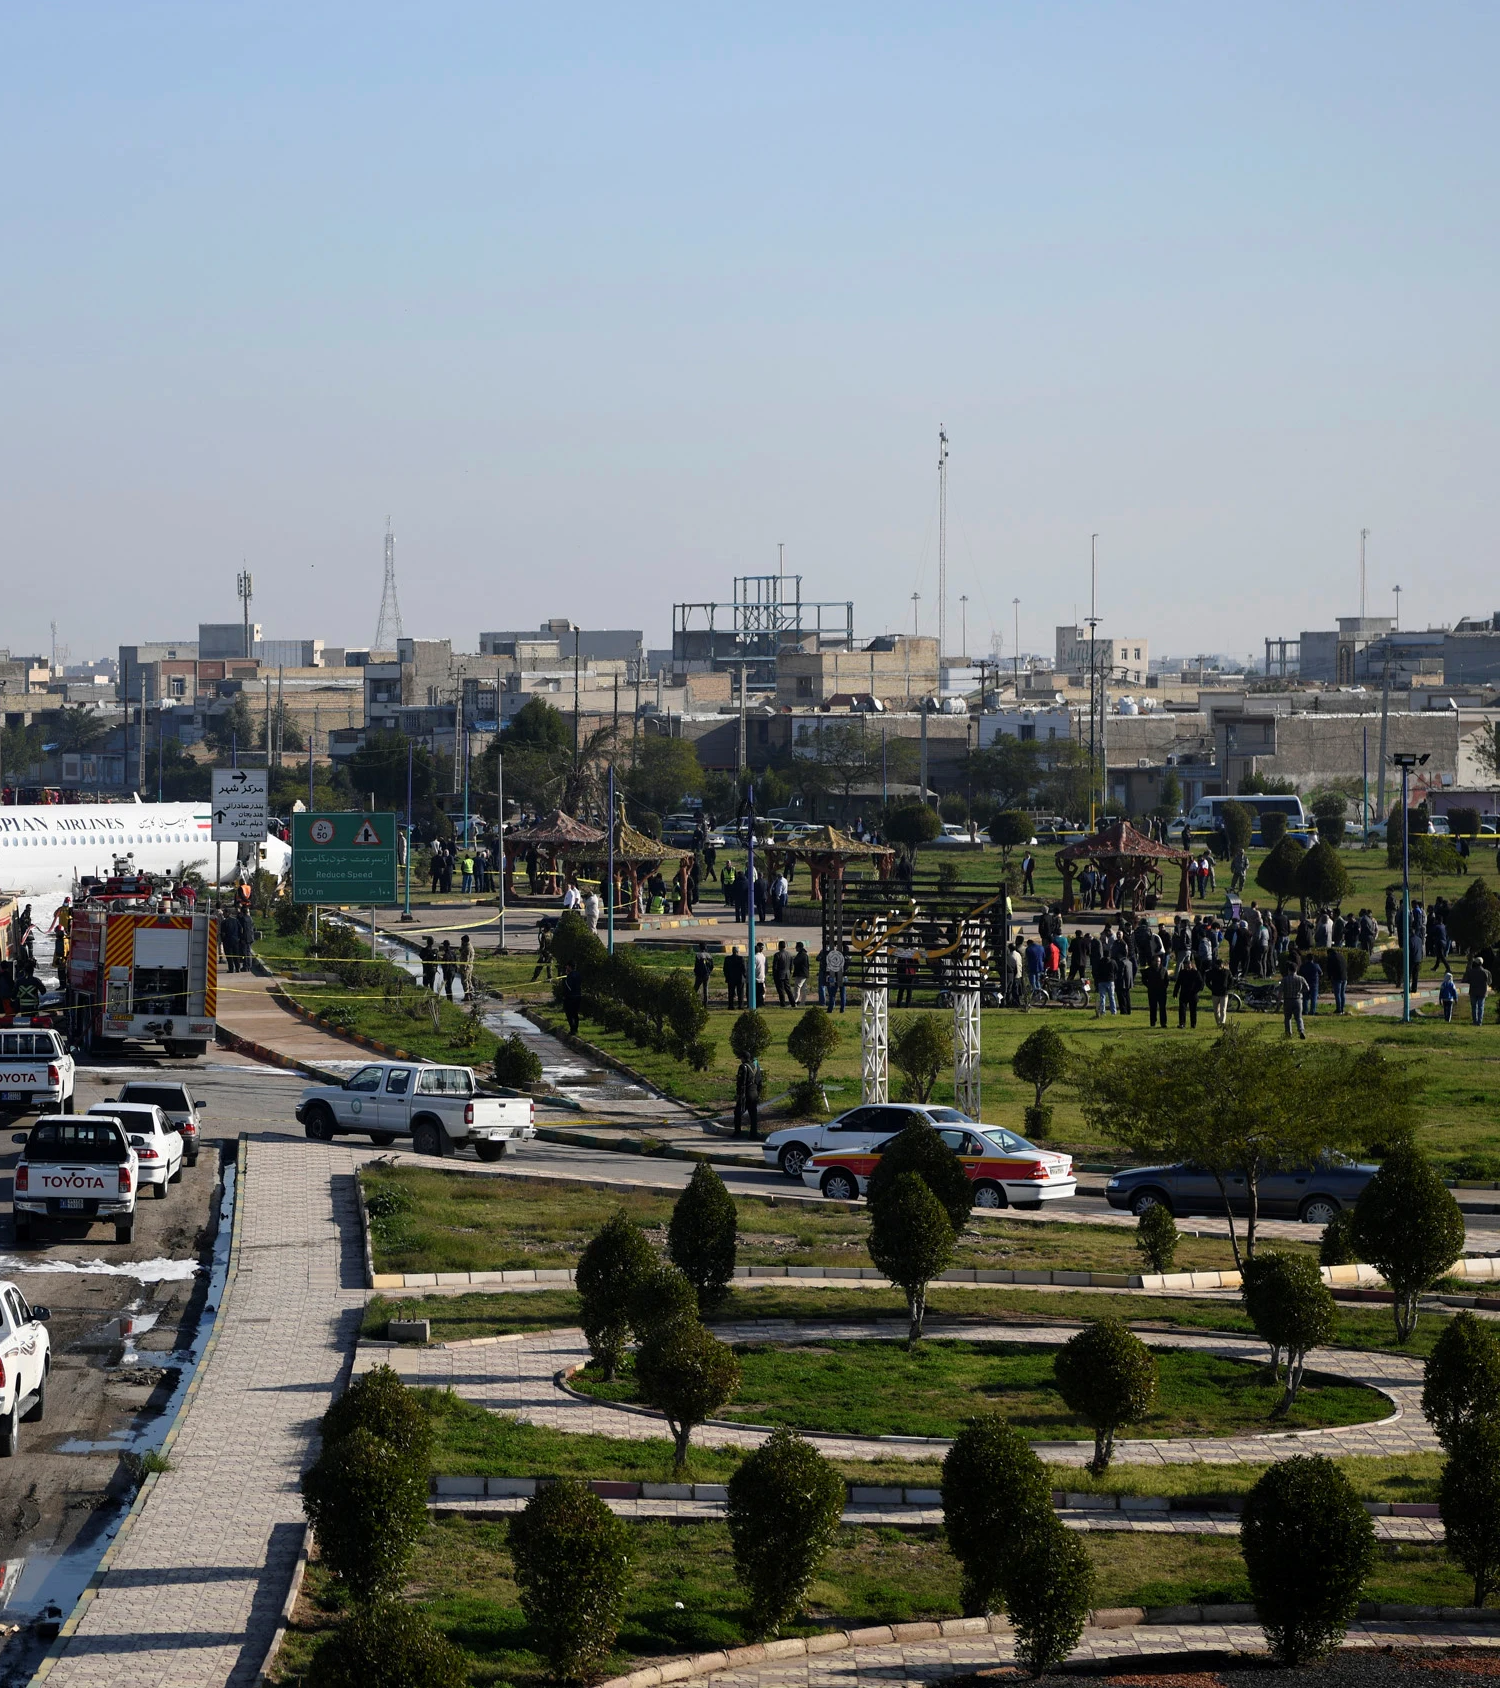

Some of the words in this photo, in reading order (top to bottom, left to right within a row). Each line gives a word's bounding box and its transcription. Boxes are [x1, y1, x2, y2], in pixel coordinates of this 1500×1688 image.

[218, 784, 239, 795] شهر
[241, 784, 264, 795] مرکز
[56, 818, 125, 831] AIRLINES
[317, 832, 328, 840] 50
[316, 871, 345, 879] Reduce
[347, 870, 373, 880] Speed
[298, 887, 314, 896] 100
[41, 1175, 105, 1189] TOYOTA
